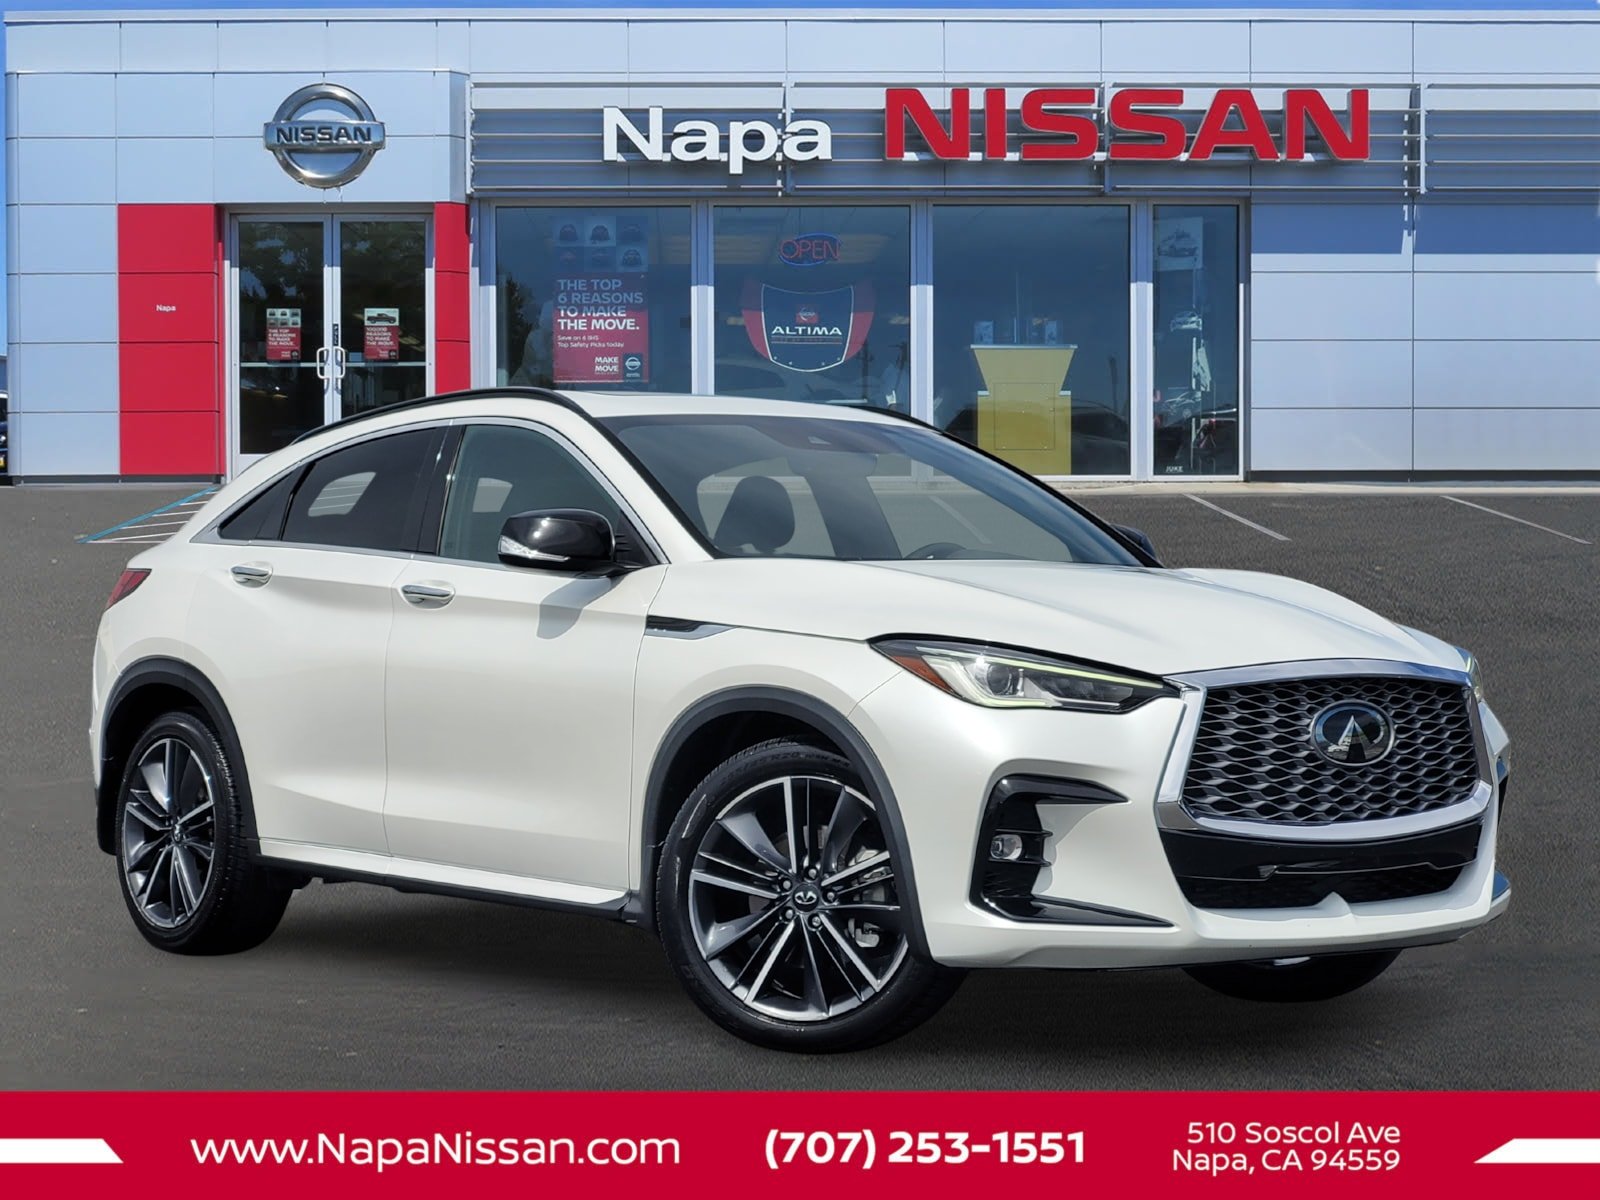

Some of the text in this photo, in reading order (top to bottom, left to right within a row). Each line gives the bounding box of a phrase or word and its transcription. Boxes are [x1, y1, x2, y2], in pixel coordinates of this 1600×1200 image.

[276, 126, 372, 144] NISSAN
[602, 88, 1370, 174] Napa NISSAN
[780, 239, 841, 260] OPEN
[557, 279, 622, 290] THE TOP
[558, 292, 644, 304] 6 REASONS
[156, 304, 176, 312] Napa
[557, 306, 627, 317] TO MAKE
[557, 319, 640, 331] THE MOVE.
[771, 326, 842, 336] ALTIMA
